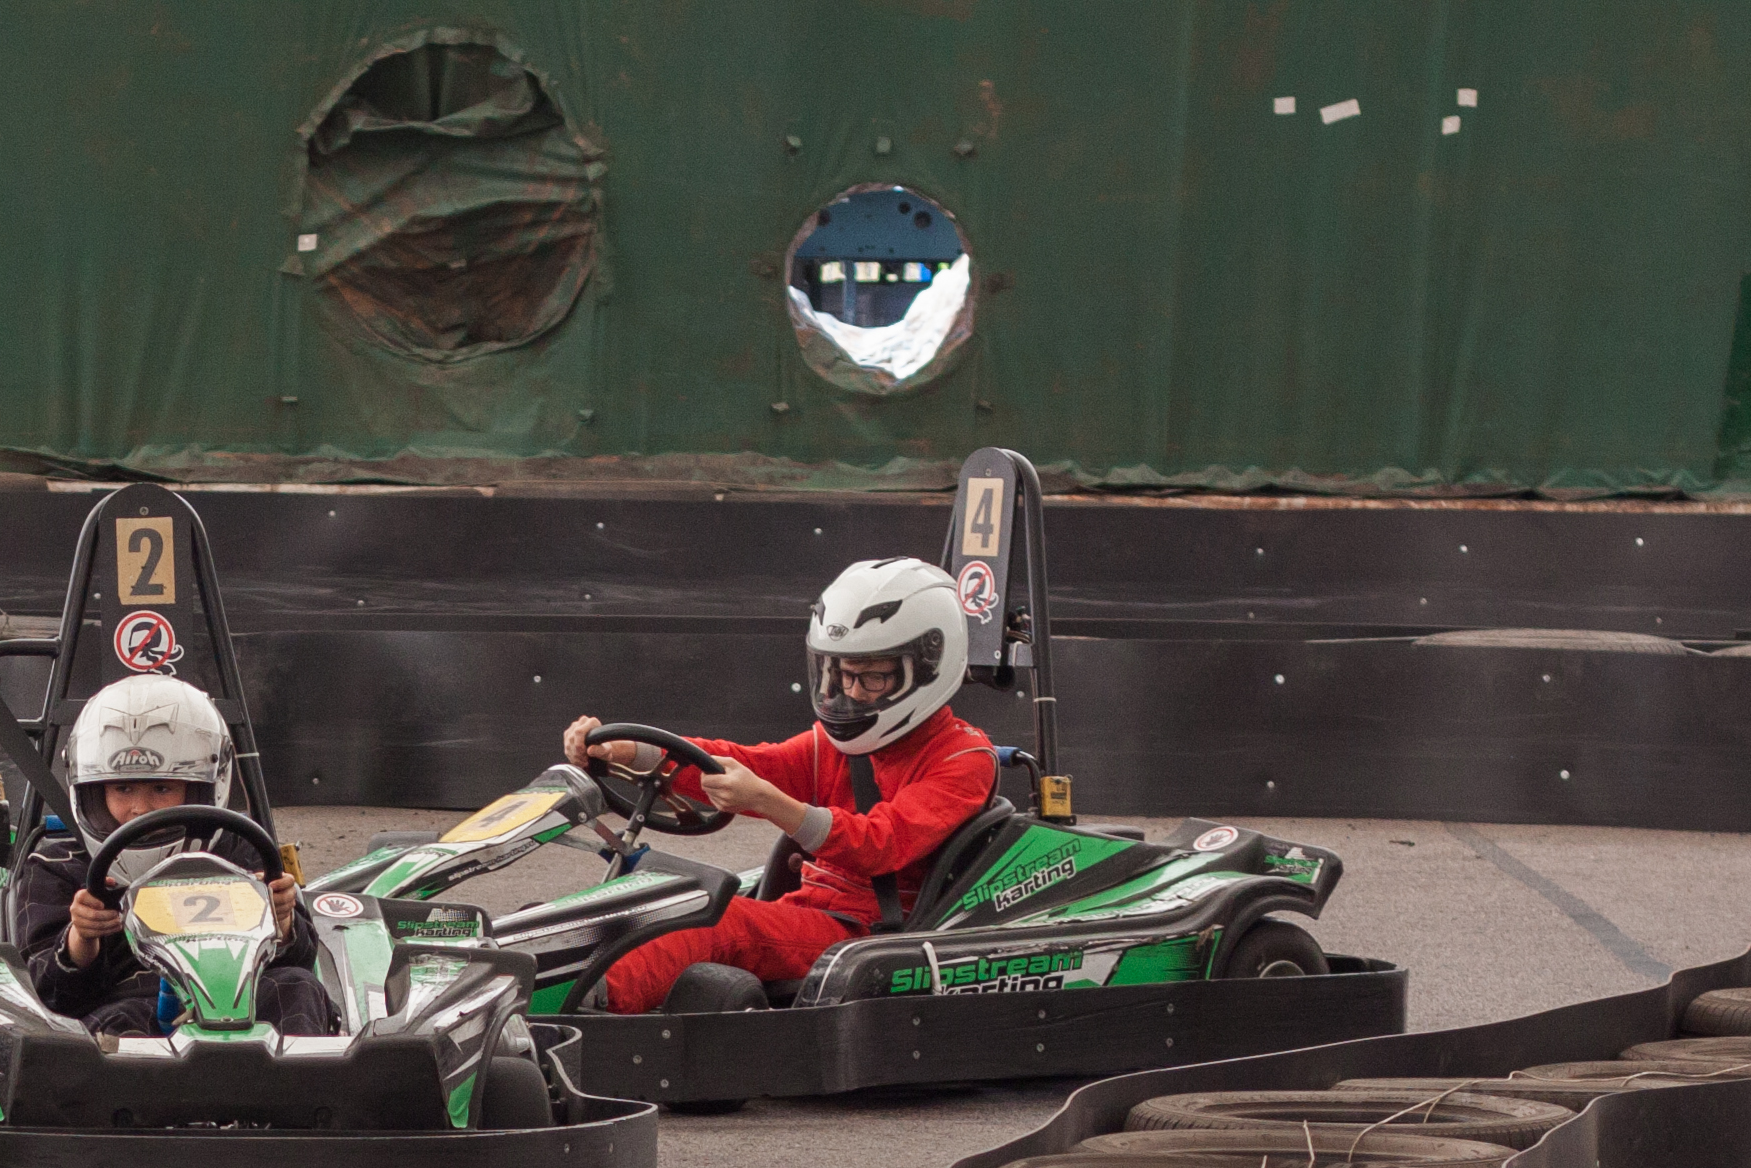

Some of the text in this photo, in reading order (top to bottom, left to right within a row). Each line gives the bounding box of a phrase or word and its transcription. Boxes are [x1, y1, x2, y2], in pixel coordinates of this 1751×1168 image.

[970, 487, 995, 549] 4
[127, 527, 166, 597] 2
[477, 800, 528, 828] 4
[993, 856, 1077, 912] karting
[183, 895, 224, 924] 2
[412, 927, 474, 937] karting
